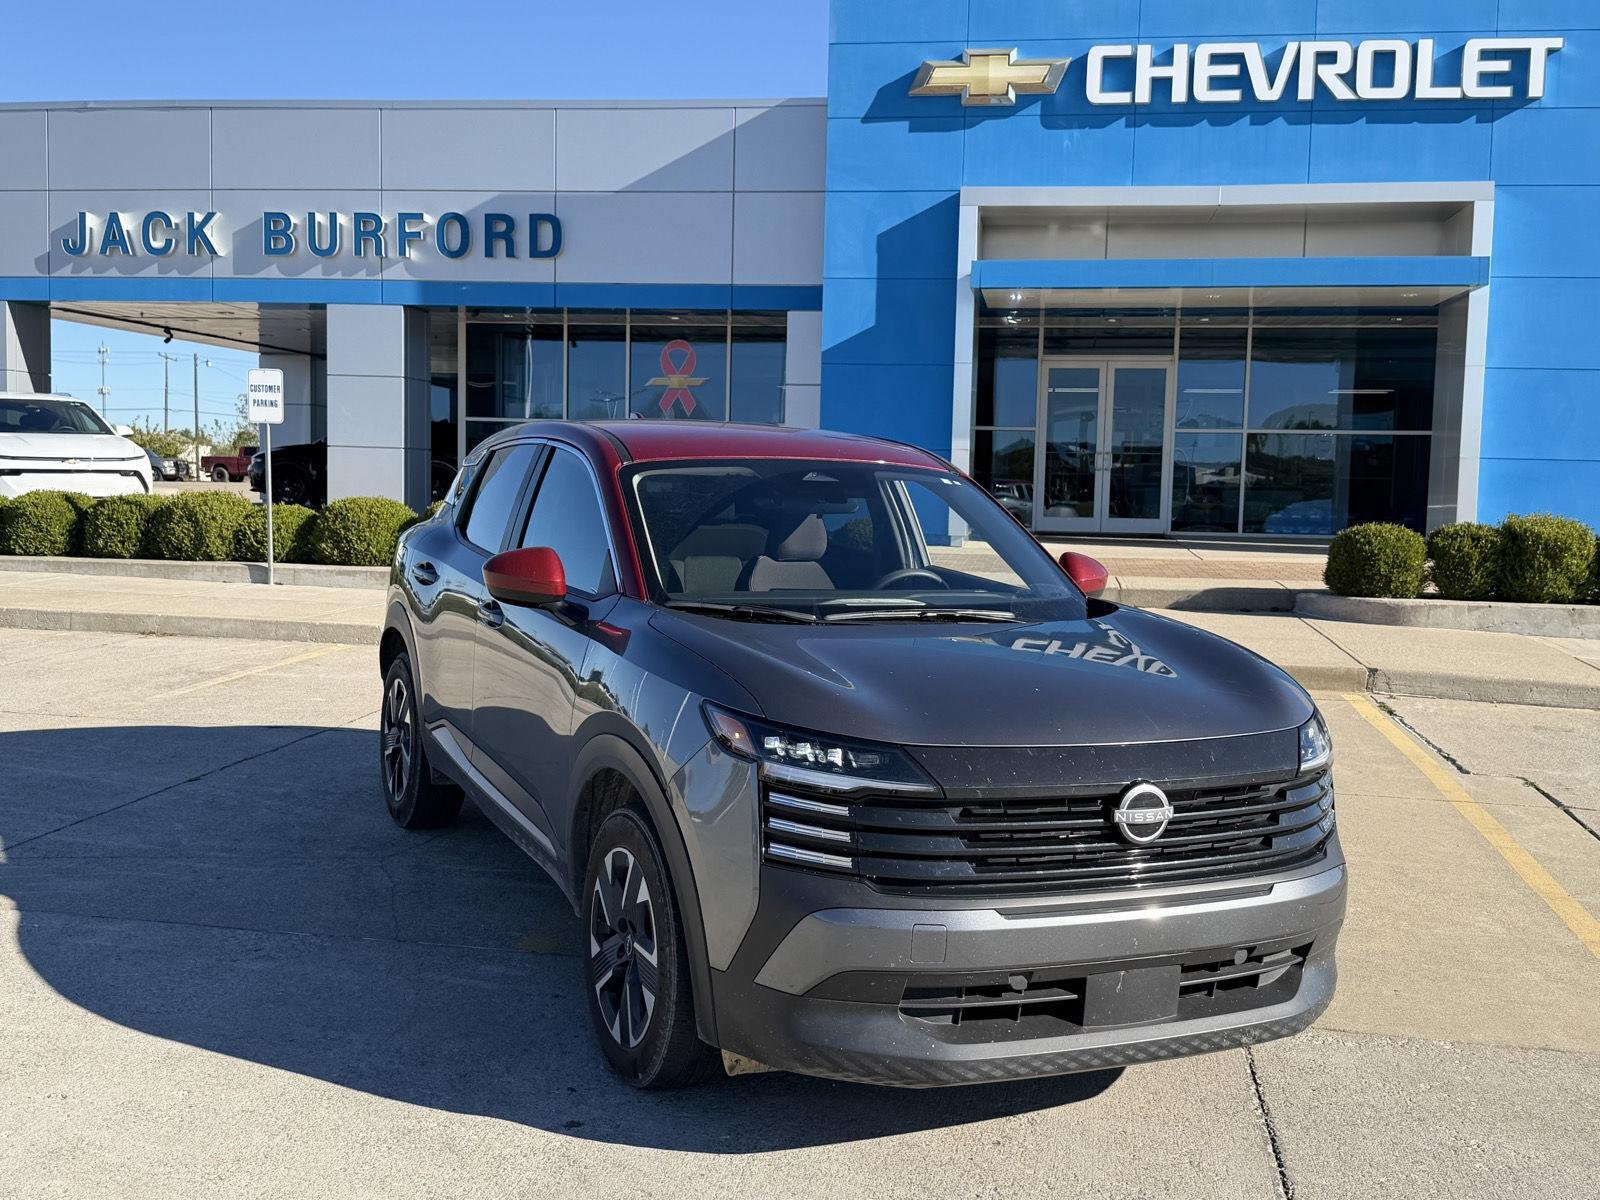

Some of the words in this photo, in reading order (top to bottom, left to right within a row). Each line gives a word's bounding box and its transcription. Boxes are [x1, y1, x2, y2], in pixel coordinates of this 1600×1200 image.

[1085, 36, 1564, 105] CHEVROLET
[61, 210, 222, 257] JACK
[262, 211, 563, 259] BURFORD
[249, 384, 281, 394] CUSTOMER
[252, 398, 278, 408] PARKING
[1115, 807, 1174, 823] NISSAN
